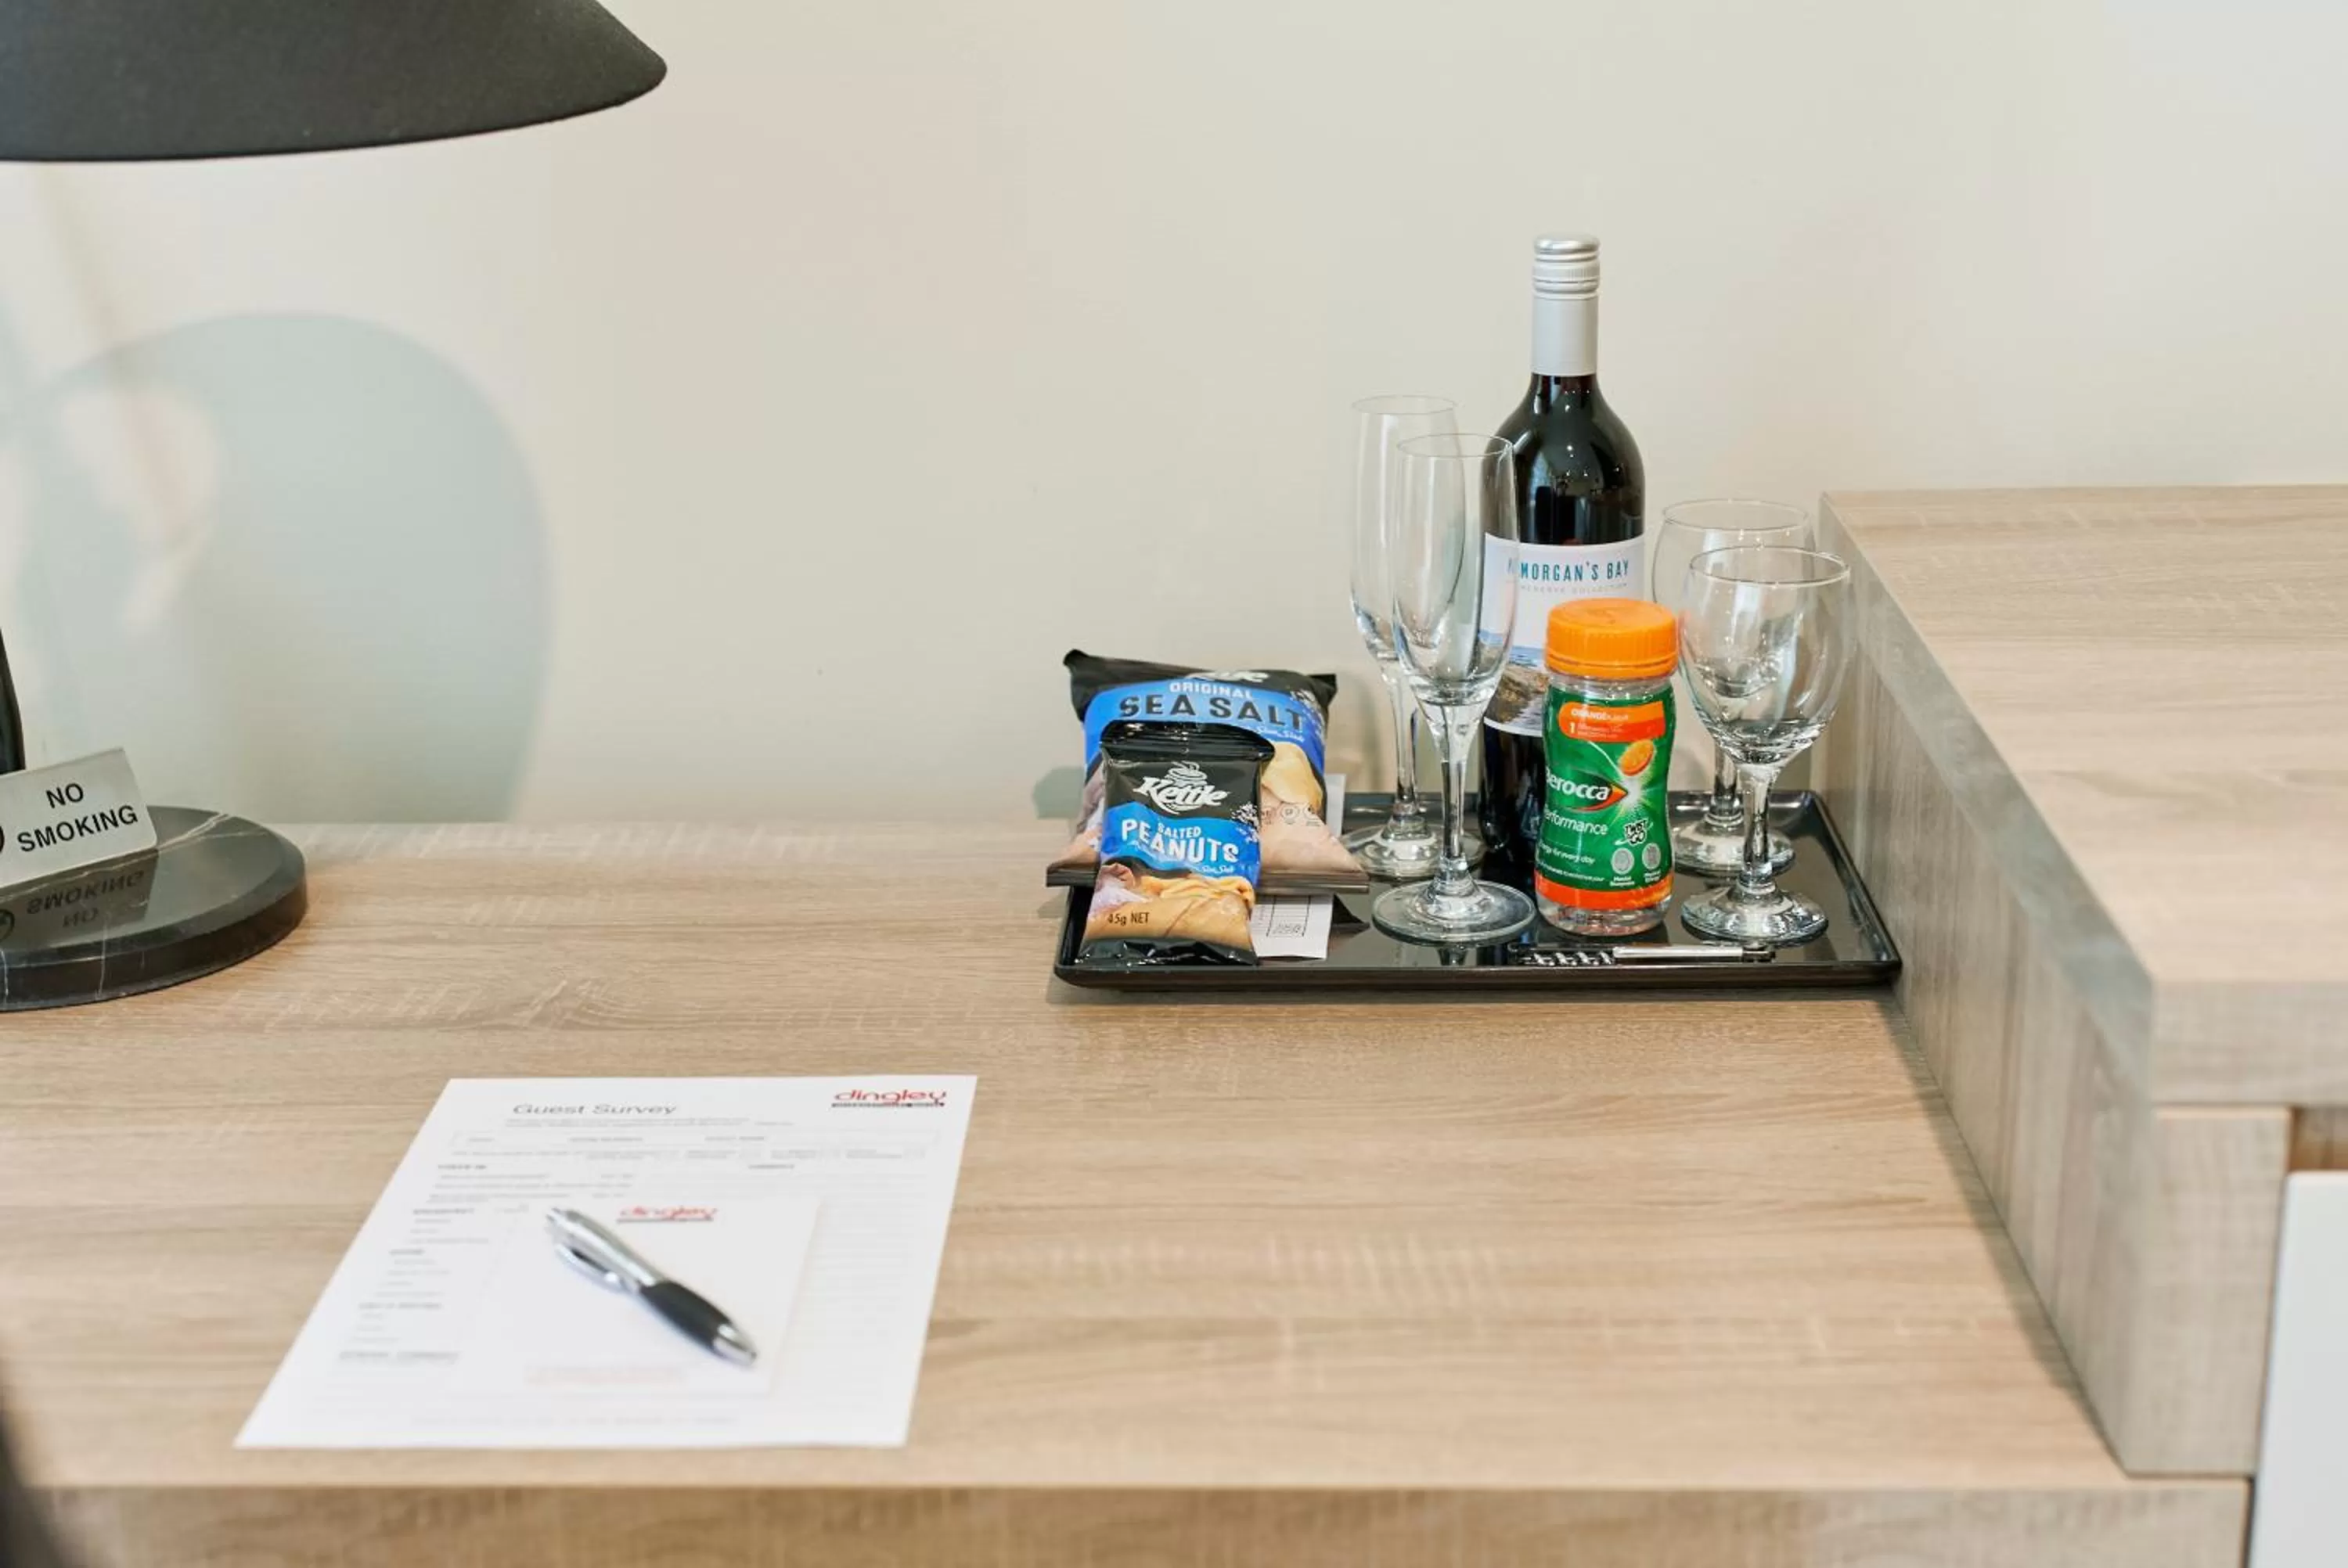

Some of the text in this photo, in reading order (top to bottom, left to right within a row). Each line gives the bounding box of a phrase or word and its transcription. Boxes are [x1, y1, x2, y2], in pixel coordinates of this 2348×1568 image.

[1521, 559, 1629, 581] MORGAN'S BAY
[1169, 681, 1251, 699] ORIGINAL
[1119, 694, 1305, 730] SEA SALT
[45, 782, 85, 809] NO
[1133, 776, 1232, 815] Kettle
[17, 805, 139, 853] SMOKING
[1122, 818, 1240, 862] PEANUTS
[1158, 822, 1202, 839] SALTED
[1107, 912, 1150, 926] 45g NET
[513, 1102, 678, 1115] Guest Survey
[834, 1090, 946, 1105] dingley
